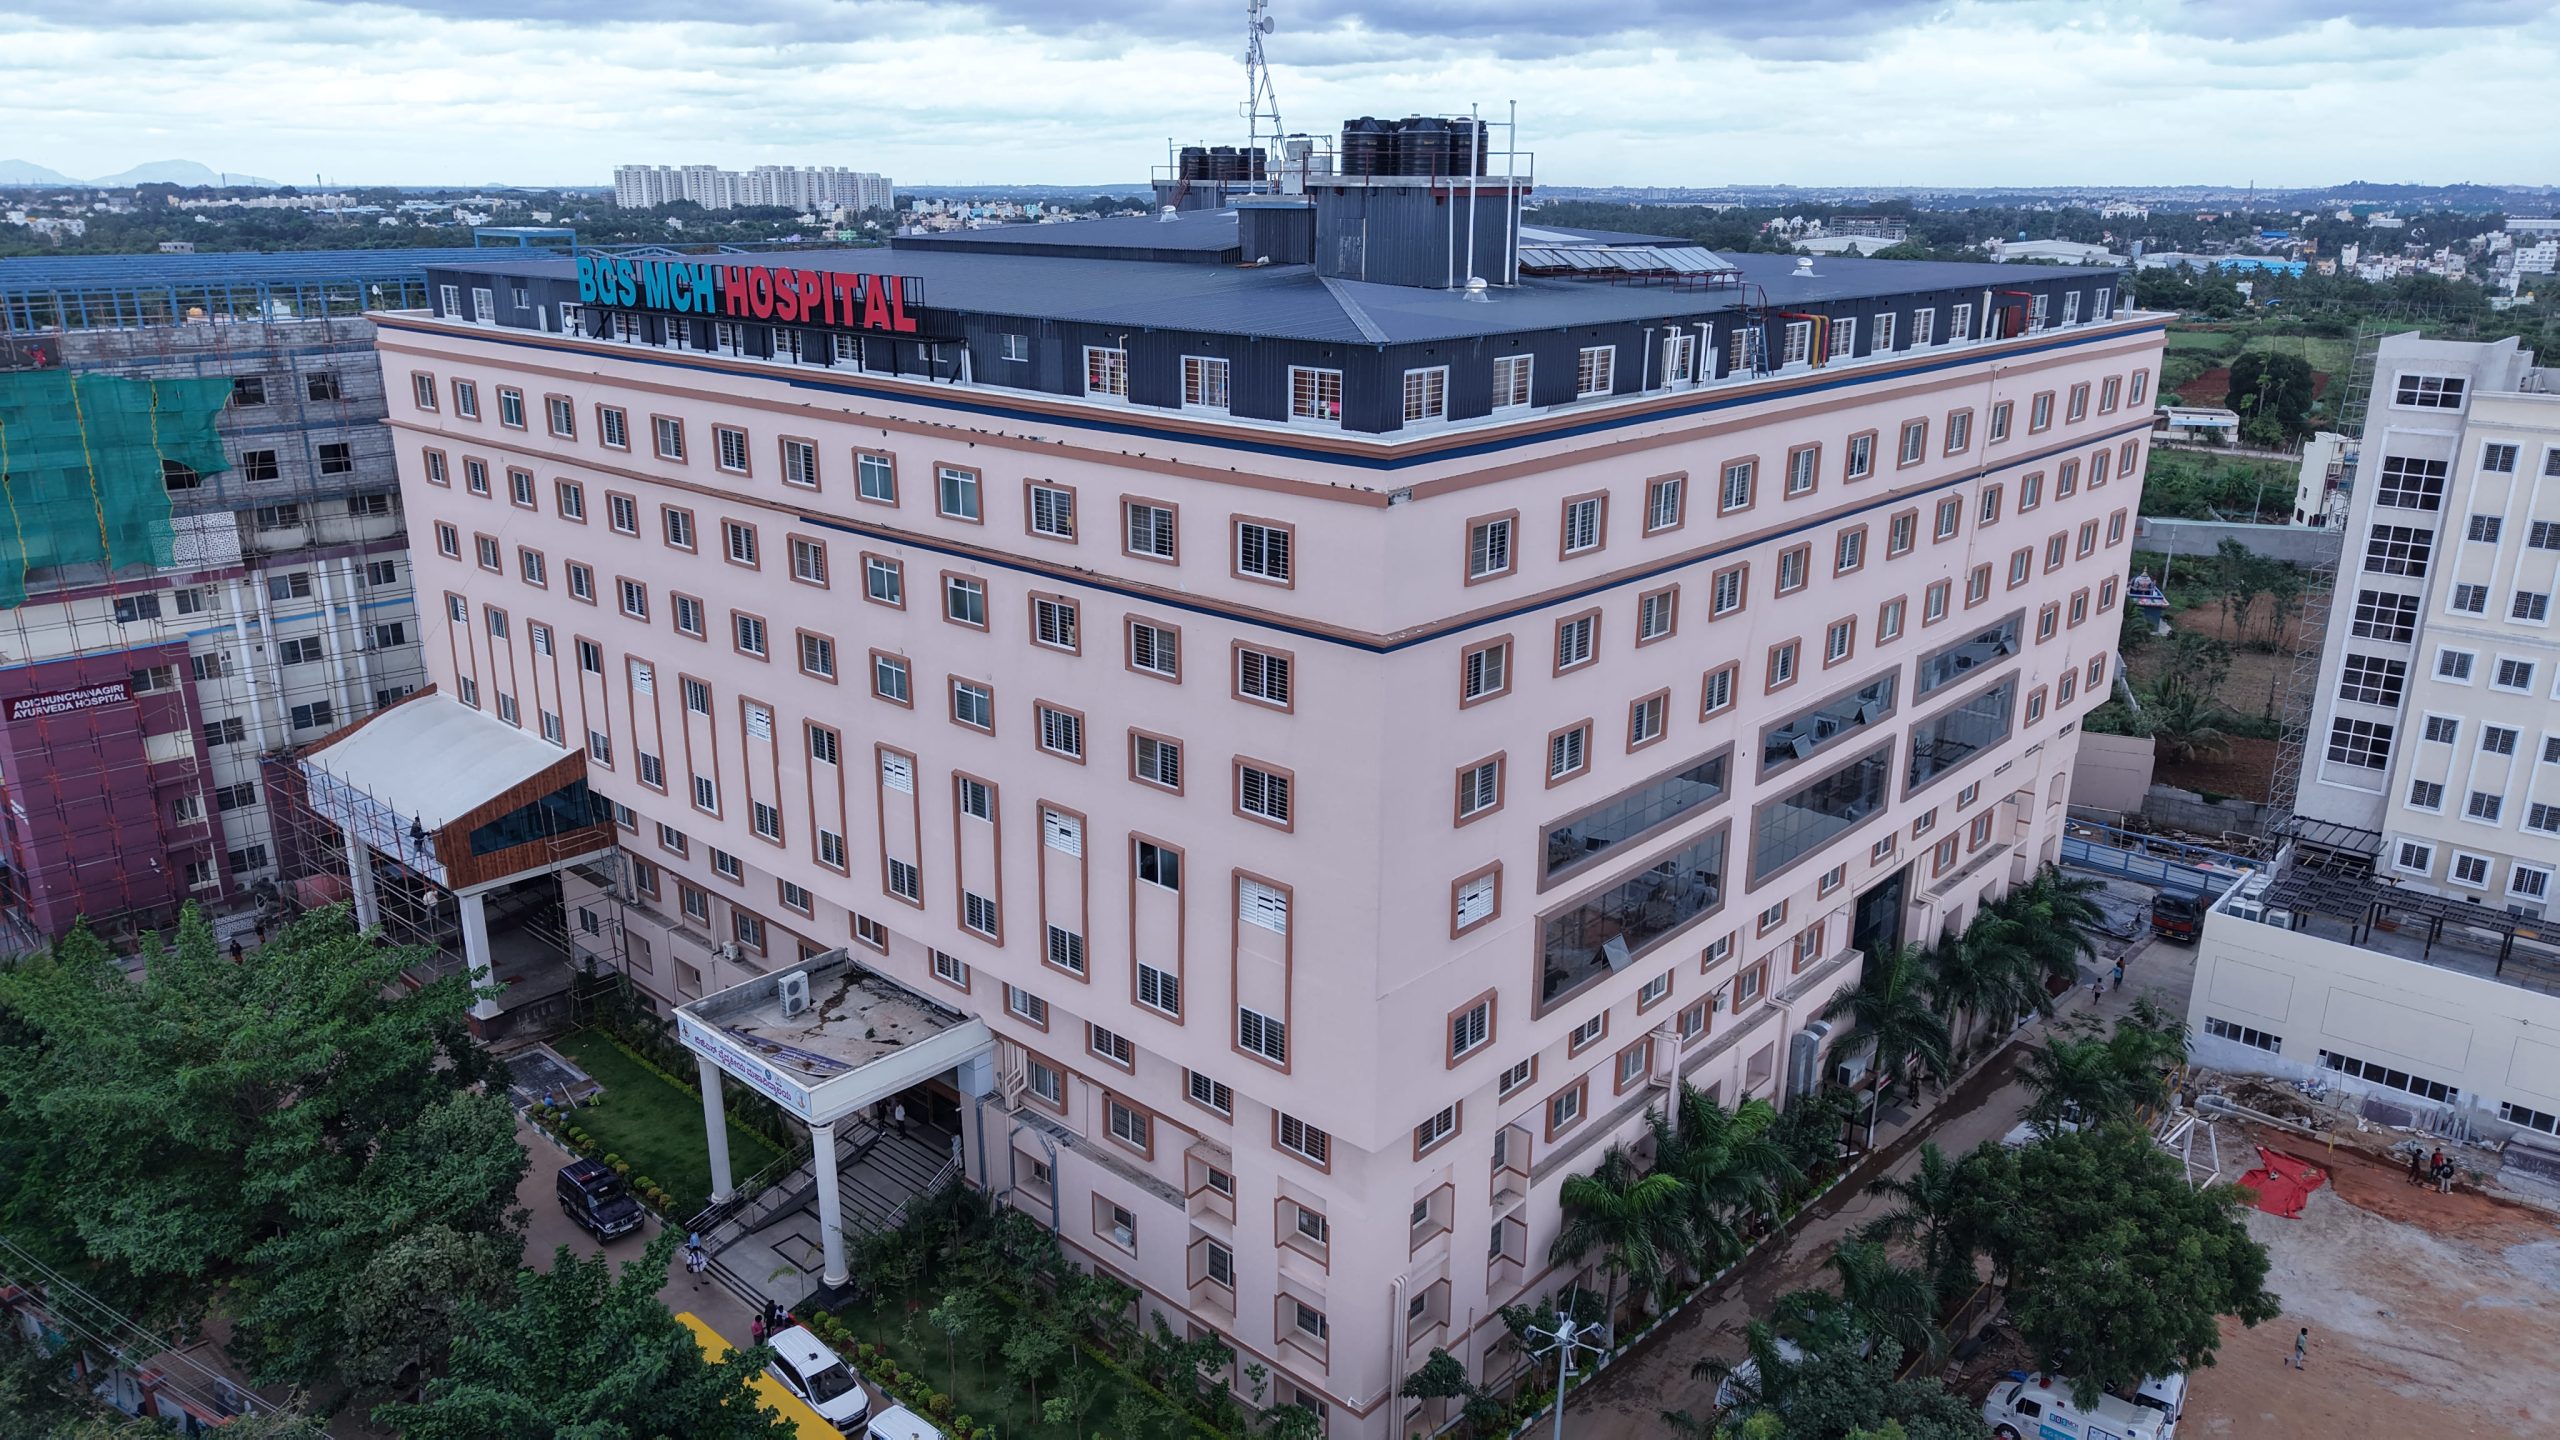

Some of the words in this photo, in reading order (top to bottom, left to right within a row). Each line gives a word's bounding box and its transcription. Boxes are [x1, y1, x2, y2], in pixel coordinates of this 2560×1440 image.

[577, 257, 637, 307] BGS
[643, 260, 716, 314] MCH
[722, 265, 917, 333] HOSPITAL
[13, 701, 74, 719] AYURVEDA
[75, 693, 128, 709] HOSPITAL
[14, 684, 125, 710] ADICHUNCHANAGIRI
